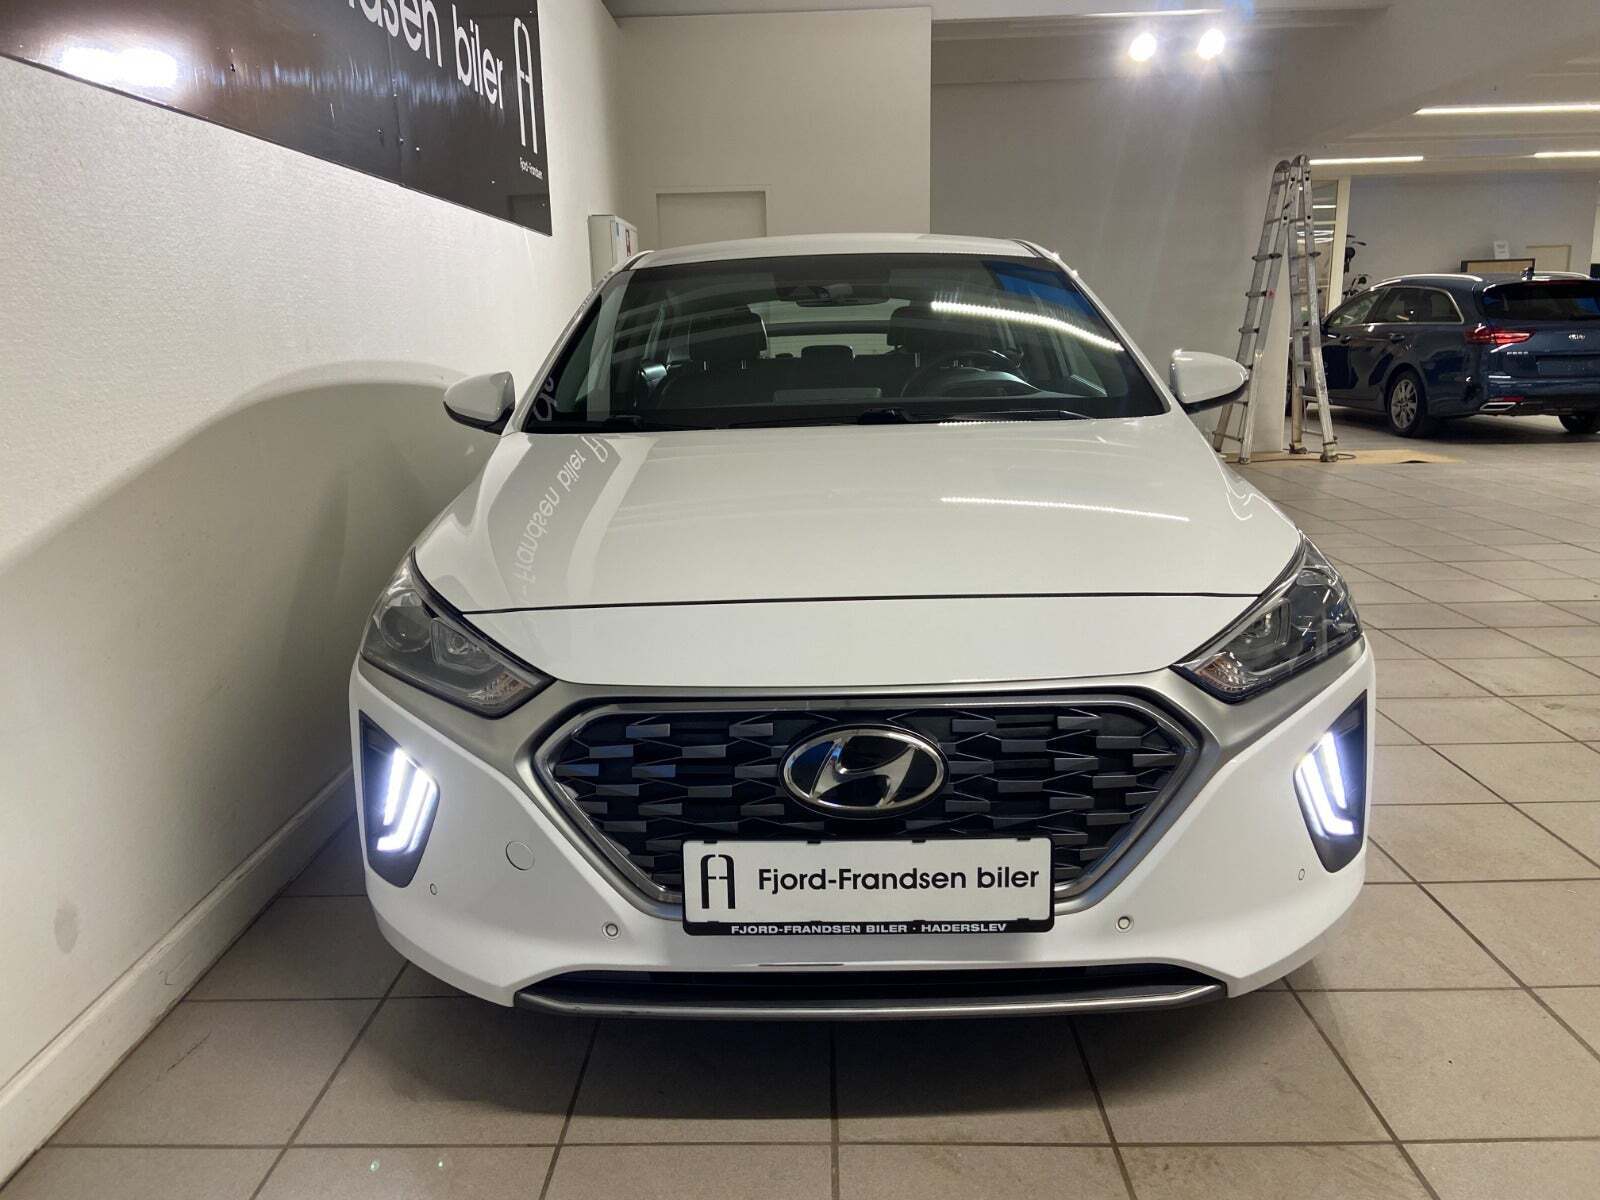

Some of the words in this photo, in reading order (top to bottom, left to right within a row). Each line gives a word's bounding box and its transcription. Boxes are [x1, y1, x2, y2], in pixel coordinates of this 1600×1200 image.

[451, 4, 504, 110] biler
[759, 869, 967, 894] Fjord-Frandsen
[977, 867, 1039, 888] biler
[731, 925, 861, 934] FJORD-FRANDSEN
[865, 924, 908, 934] BILER
[921, 924, 1007, 932] HADERSLEV
